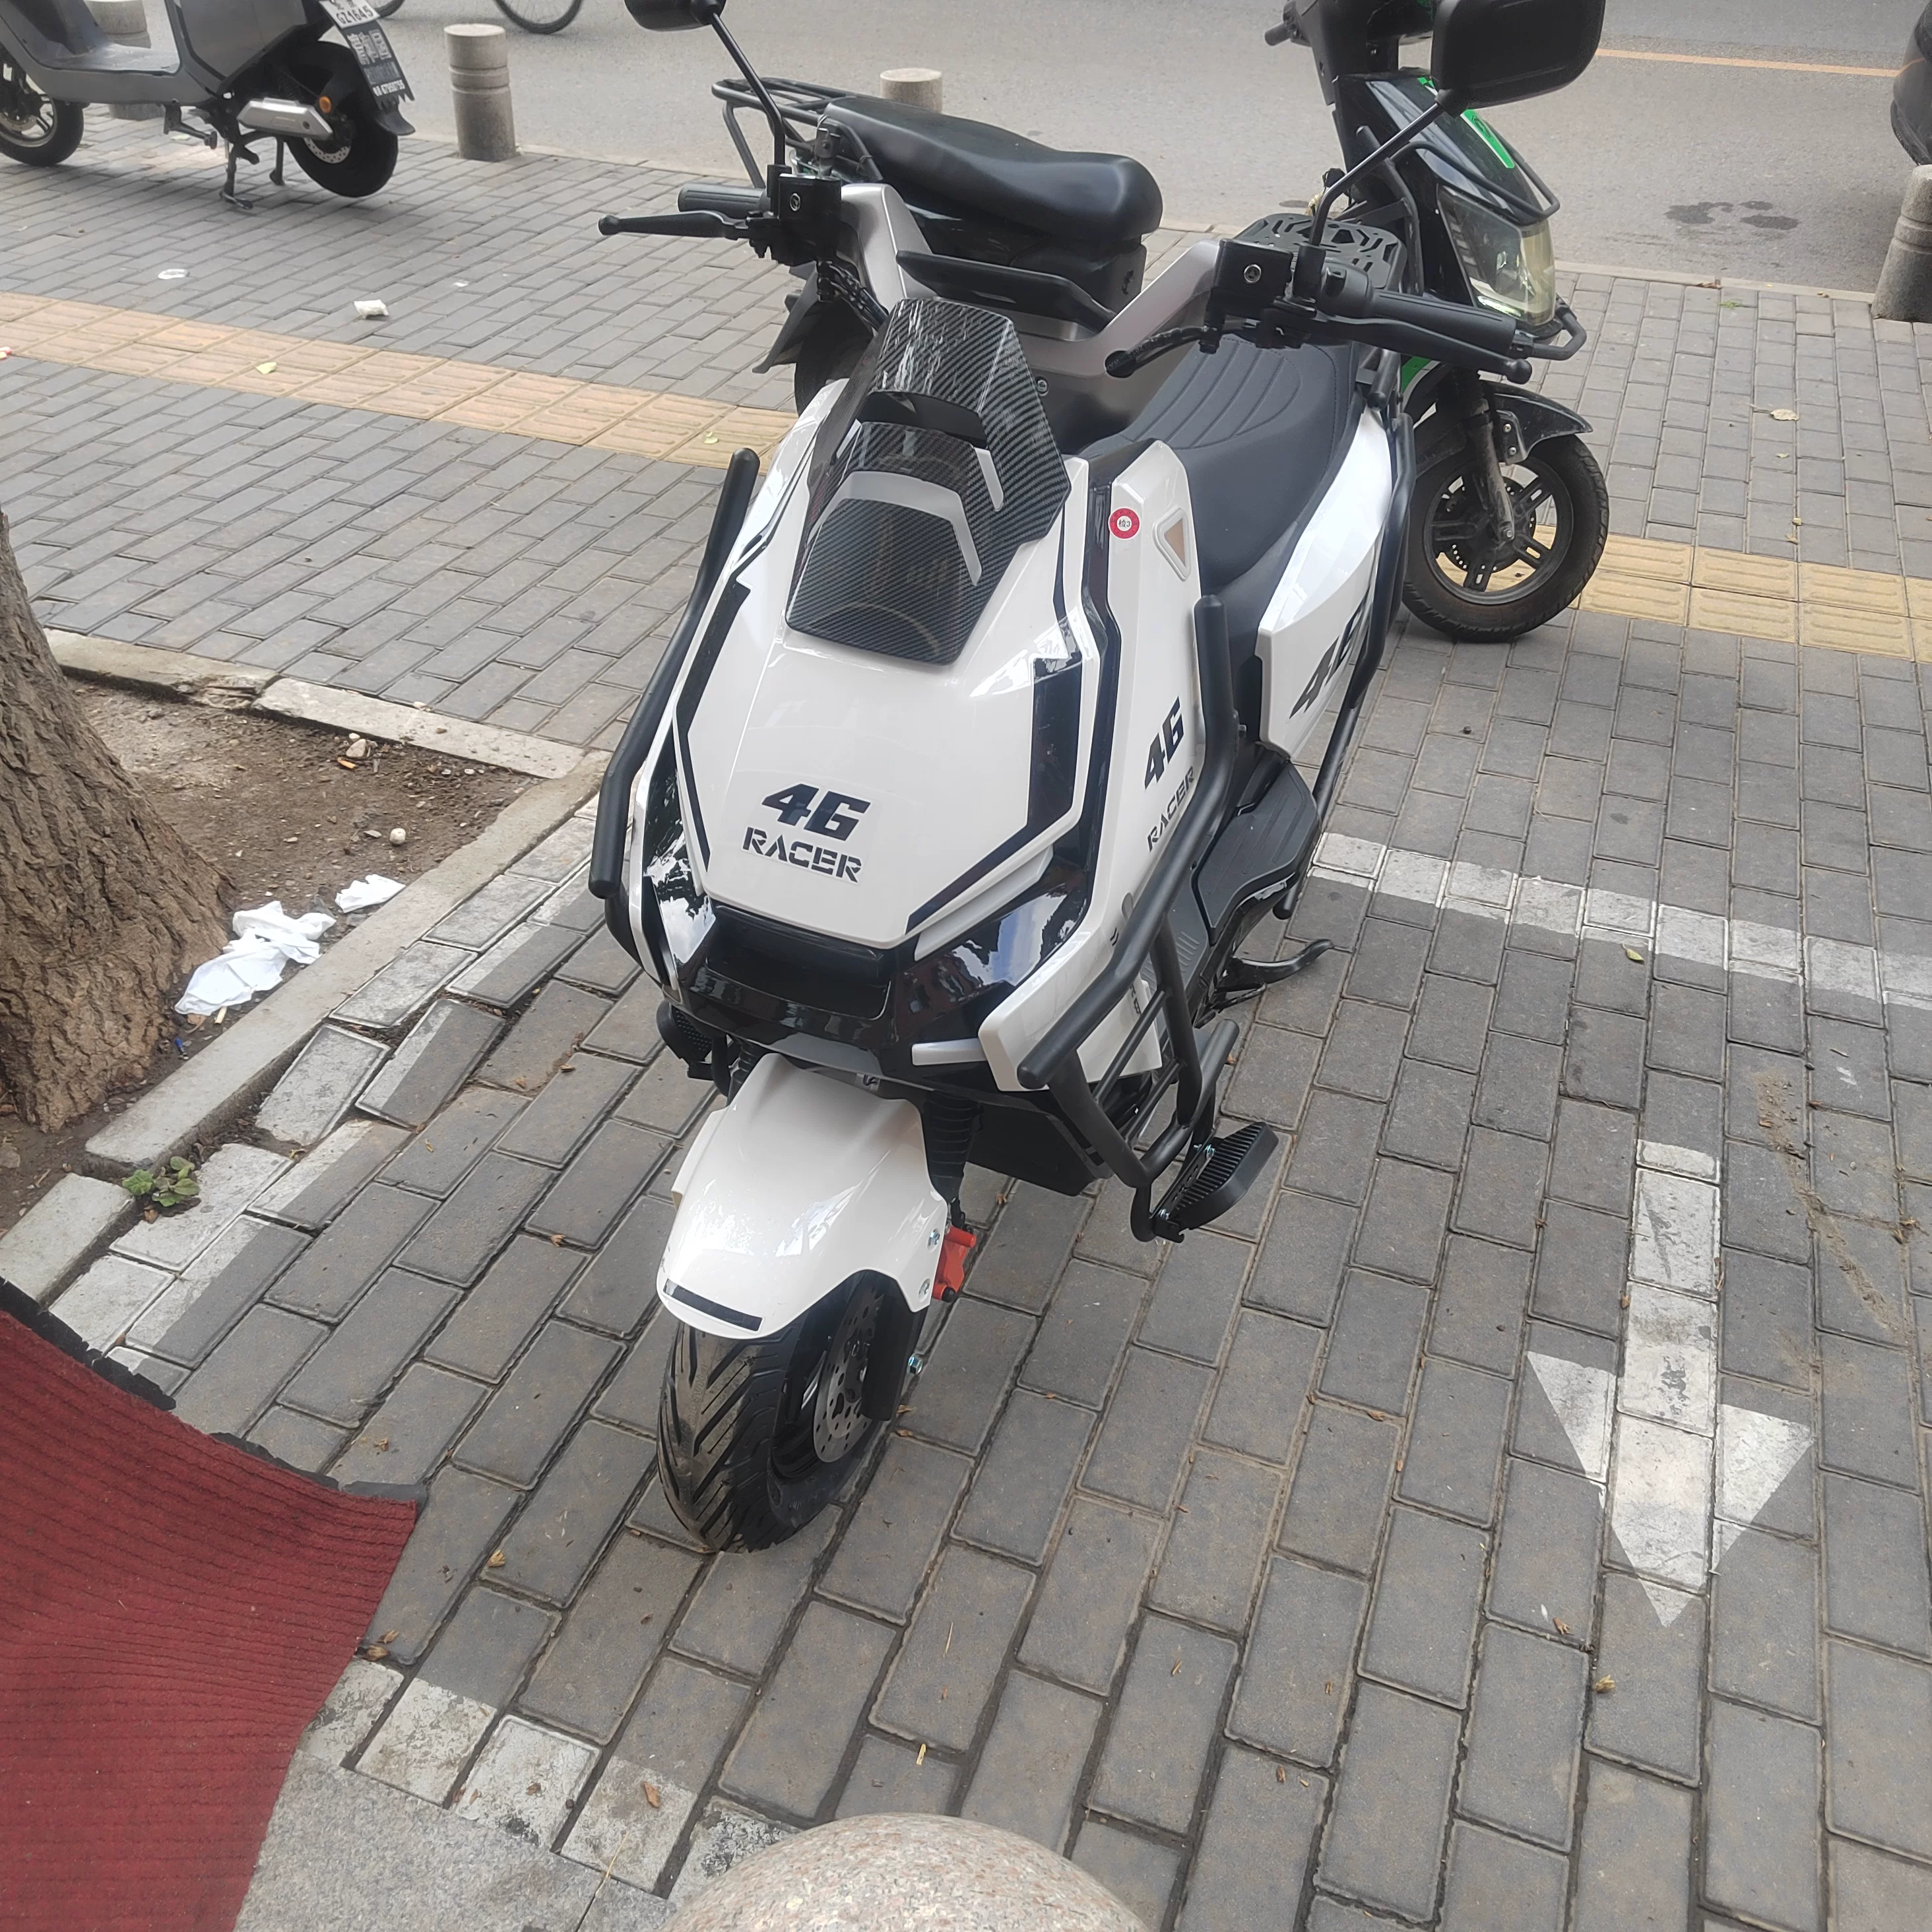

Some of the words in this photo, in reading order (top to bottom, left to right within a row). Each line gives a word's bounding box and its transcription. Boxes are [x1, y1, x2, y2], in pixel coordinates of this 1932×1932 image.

[1144, 695, 1184, 790] 46
[761, 783, 871, 841] 46
[1147, 765, 1194, 853] RACER
[743, 826, 862, 883] RACER
